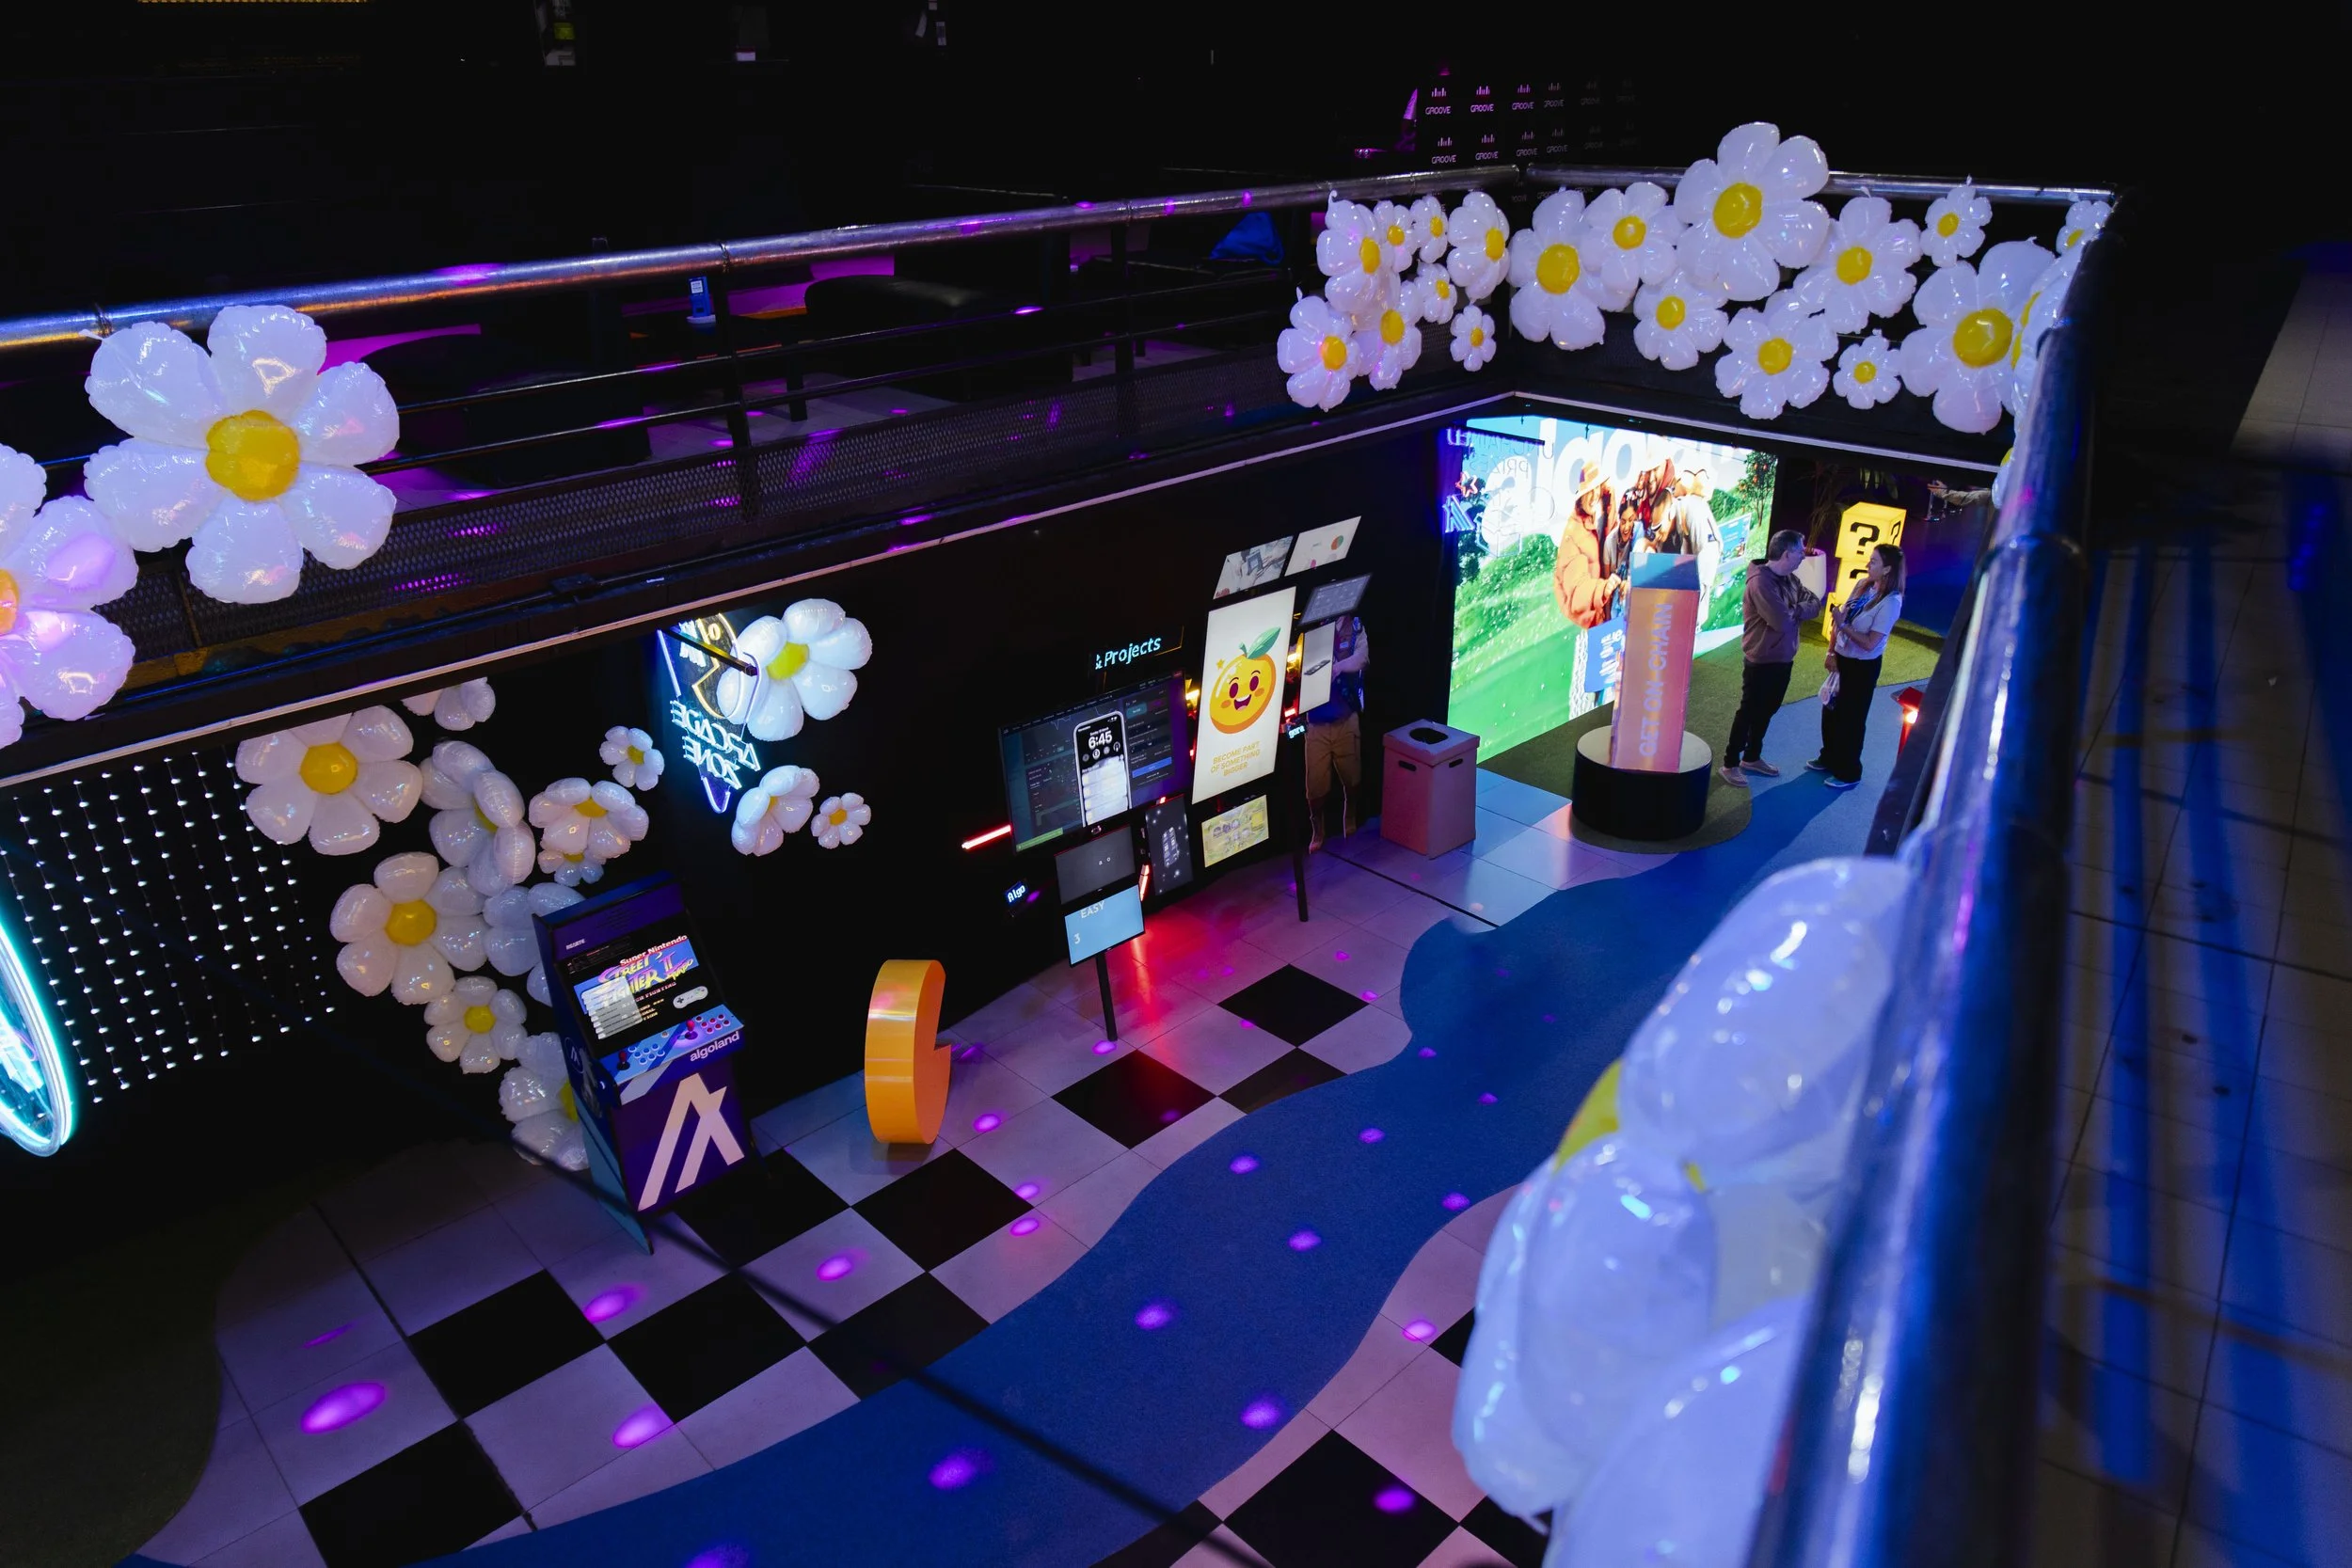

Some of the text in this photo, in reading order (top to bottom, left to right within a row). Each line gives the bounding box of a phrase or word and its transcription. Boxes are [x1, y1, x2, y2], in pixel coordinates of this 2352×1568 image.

[1424, 105, 1452, 116] GROOVE
[1470, 103, 1495, 113] GROOVE
[1511, 101, 1535, 111] GROOVE
[1544, 99, 1565, 108] GROOVE
[1475, 151, 1499, 161] GROOVE
[1516, 149, 1539, 157] GROOVE
[1547, 145, 1569, 153] GROOVE
[1431, 154, 1457, 165] GROOVE
[1104, 637, 1162, 667] Projects
[1088, 731, 1113, 750] 6:45
[1639, 717, 1661, 757] GET
[1213, 741, 1260, 764] BECOME PART
[1210, 750, 1261, 773] OF SOMETHING
[1223, 762, 1248, 776] BIGGER
[1007, 885, 1025, 903] Algo
[1080, 900, 1105, 919] EASY
[1073, 933, 1081, 944] 3
[619, 934, 688, 966] Super Nintendo
[690, 1031, 740, 1062] algoland
